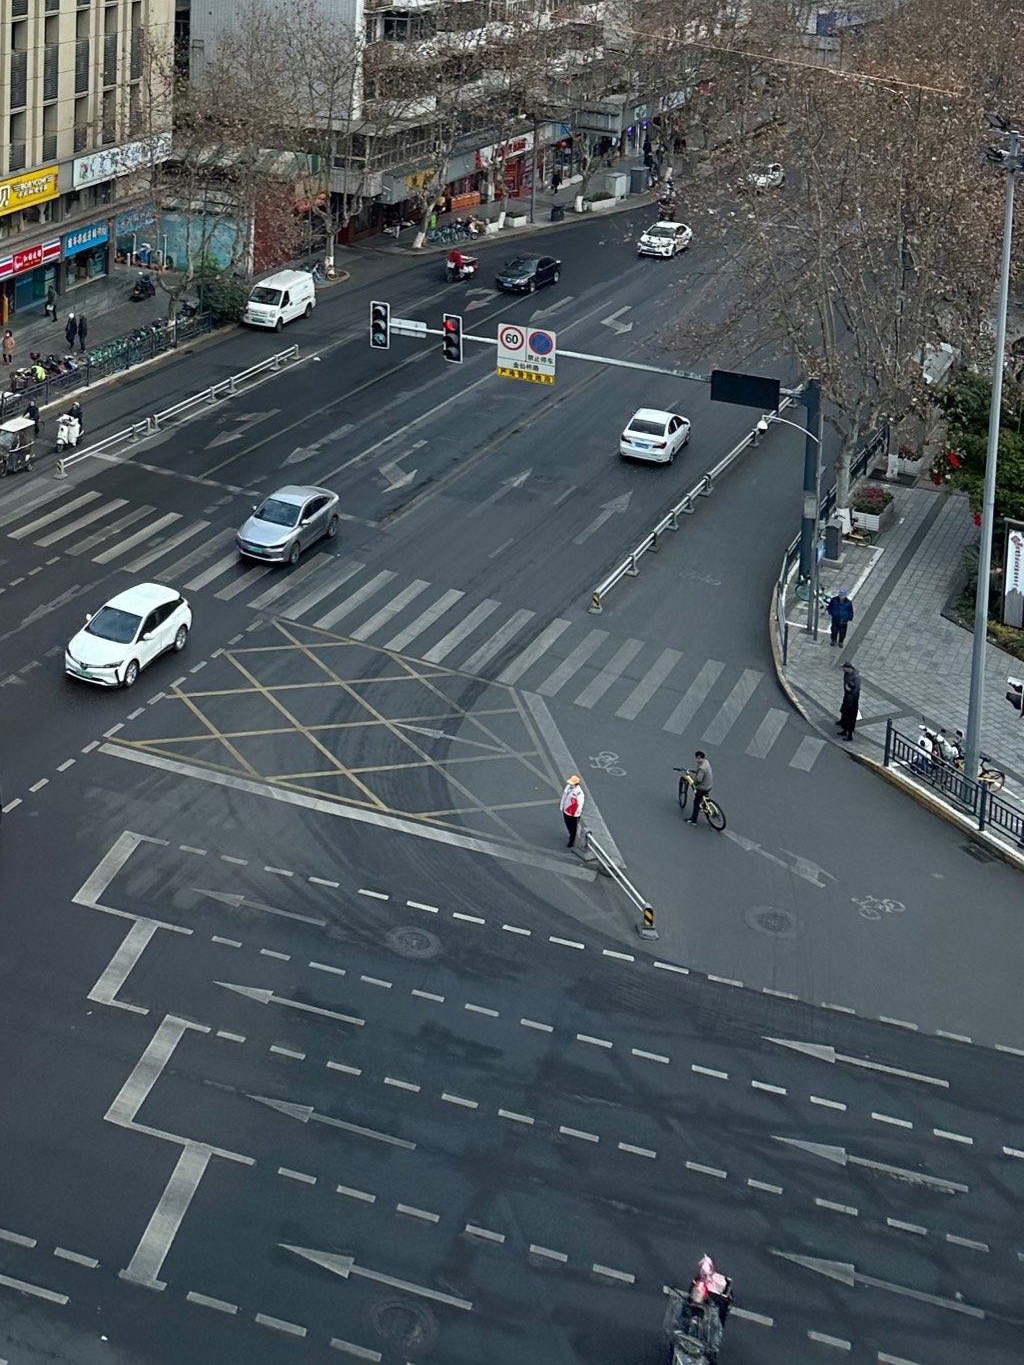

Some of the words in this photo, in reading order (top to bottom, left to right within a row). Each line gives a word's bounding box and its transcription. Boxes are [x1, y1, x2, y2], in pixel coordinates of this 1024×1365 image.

[506, 333, 518, 344] 60
[528, 355, 553, 364] 禁止停车
